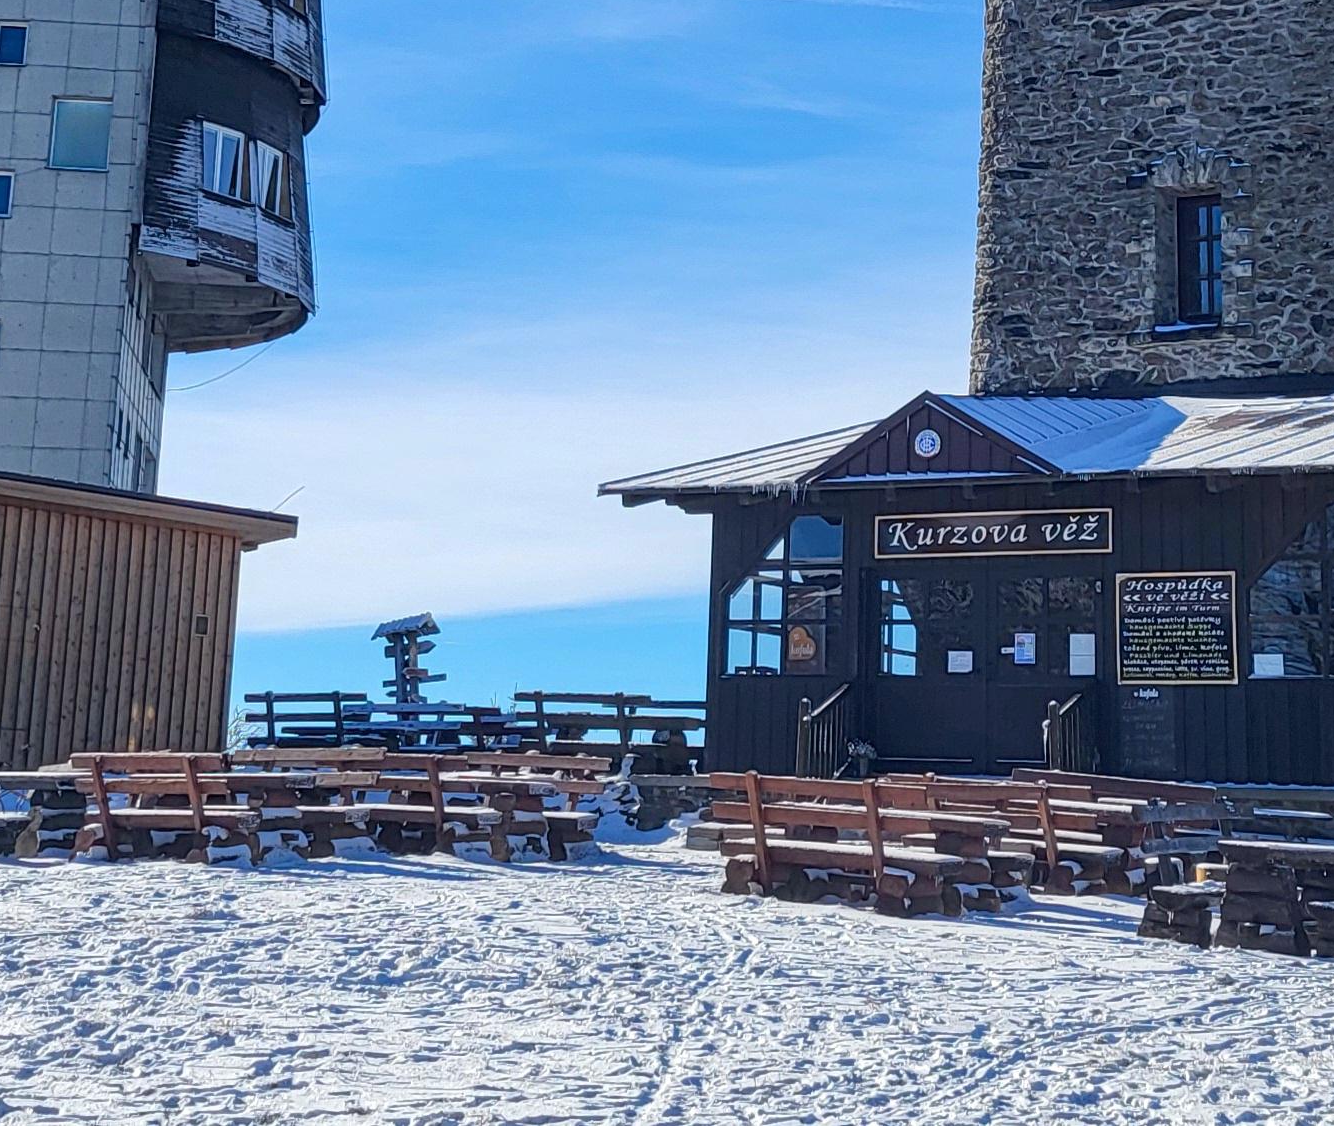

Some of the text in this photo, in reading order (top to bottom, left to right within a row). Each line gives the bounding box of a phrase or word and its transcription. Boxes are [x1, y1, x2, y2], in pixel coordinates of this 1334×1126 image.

[888, 514, 1100, 551] Kurzova věž
[1126, 578, 1223, 593] Hospůdka
[1146, 593, 1164, 601] ve
[1170, 591, 1205, 601] věži
[1125, 604, 1171, 614] Kneipe
